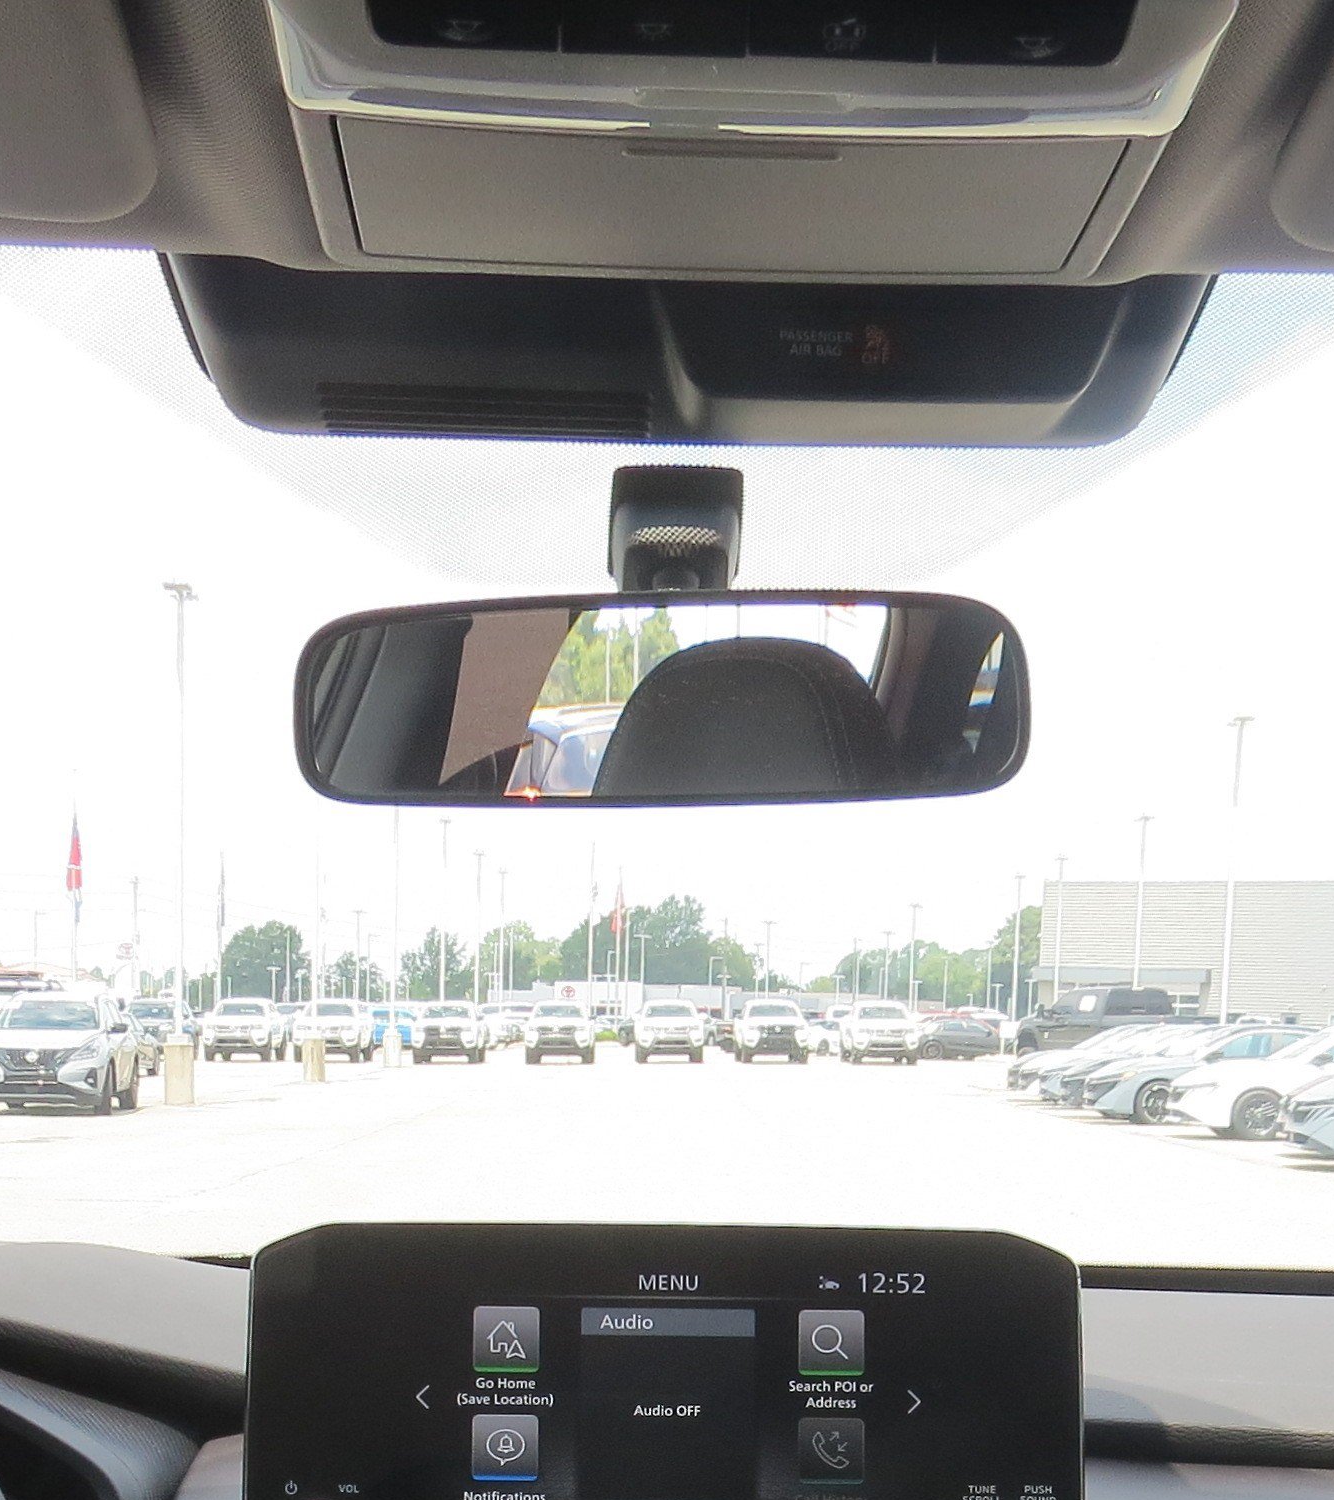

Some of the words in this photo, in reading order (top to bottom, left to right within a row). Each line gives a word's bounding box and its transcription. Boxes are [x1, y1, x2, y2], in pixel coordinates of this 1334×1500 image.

[779, 330, 853, 342] PASSENGER
[789, 343, 812, 355] AIR
[638, 1274, 699, 1291] MENU
[857, 1273, 926, 1294] 12:52
[600, 1314, 653, 1330] Audio
[475, 1377, 495, 1390] Go
[498, 1377, 537, 1390] Home
[788, 1380, 831, 1393] Search
[834, 1380, 856, 1393] POI
[859, 1384, 874, 1393] or
[457, 1393, 490, 1407] (Save
[494, 1393, 554, 1408] Location)
[805, 1396, 857, 1409] Address
[633, 1404, 673, 1418] Audio
[675, 1405, 701, 1417] OFF
[338, 1483, 360, 1494] VOL
[968, 1485, 996, 1495] TUNE
[1024, 1485, 1053, 1495] PUSH
